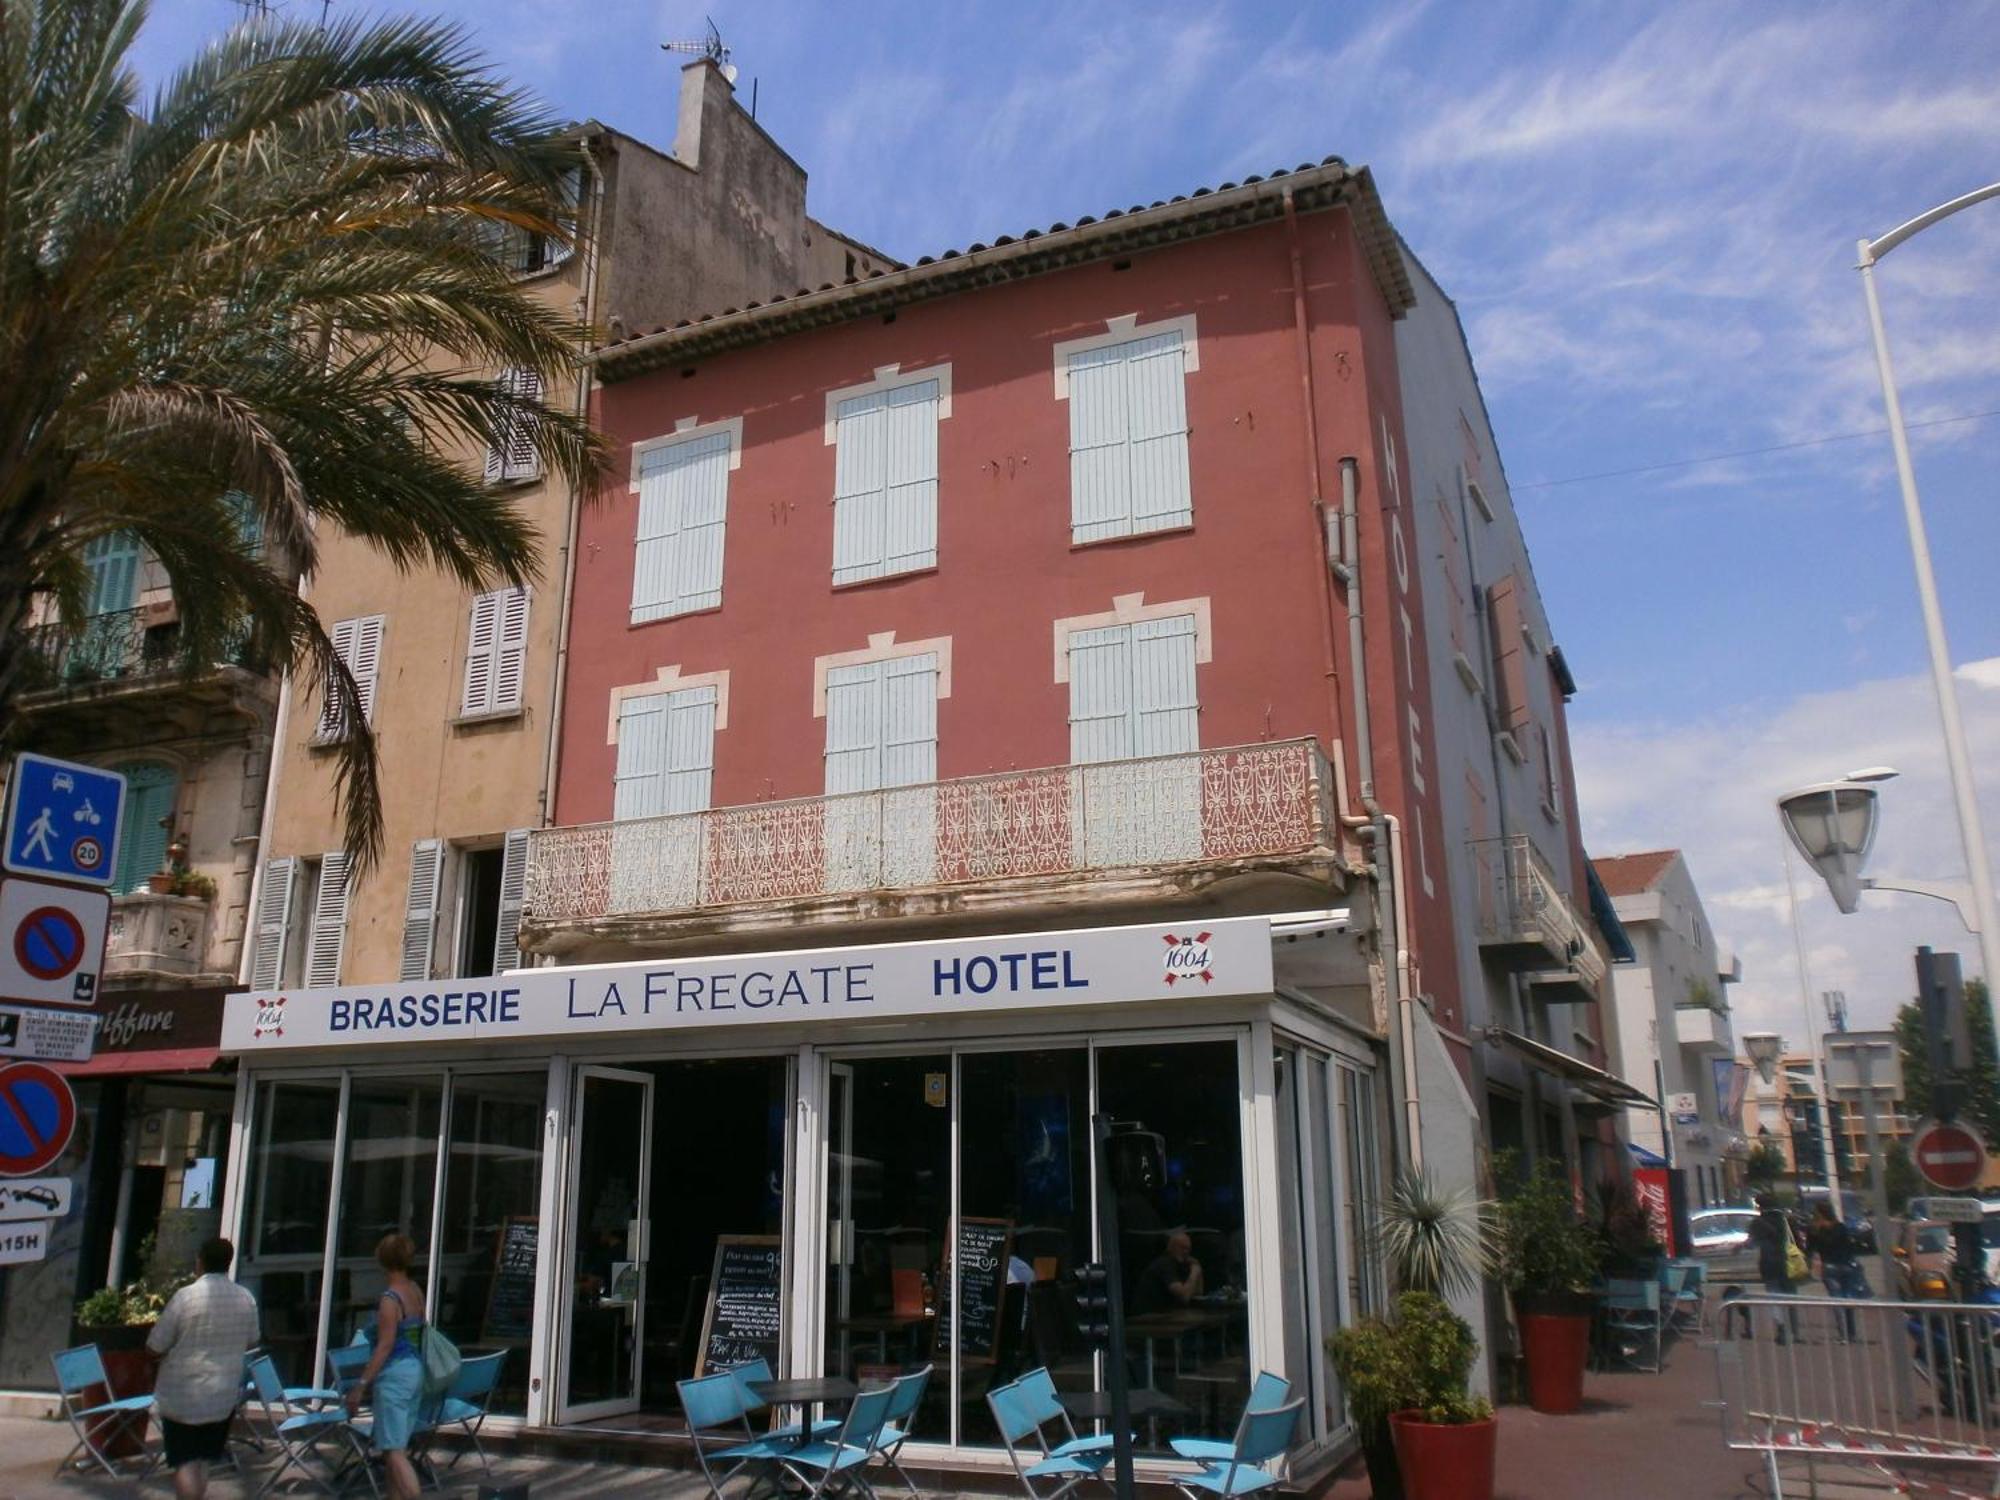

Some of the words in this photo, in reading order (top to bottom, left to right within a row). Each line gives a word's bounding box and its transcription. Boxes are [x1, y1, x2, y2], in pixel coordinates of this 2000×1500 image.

[1381, 414, 1435, 899] HOTEL
[79, 847, 96, 860] 20
[1166, 948, 1210, 969] 1664
[330, 989, 521, 1031] BRASSERIE
[567, 978, 628, 1018] LA
[643, 963, 874, 1014] FREGATE
[933, 950, 1089, 996] HOTEL
[97, 1002, 174, 1046] iffure
